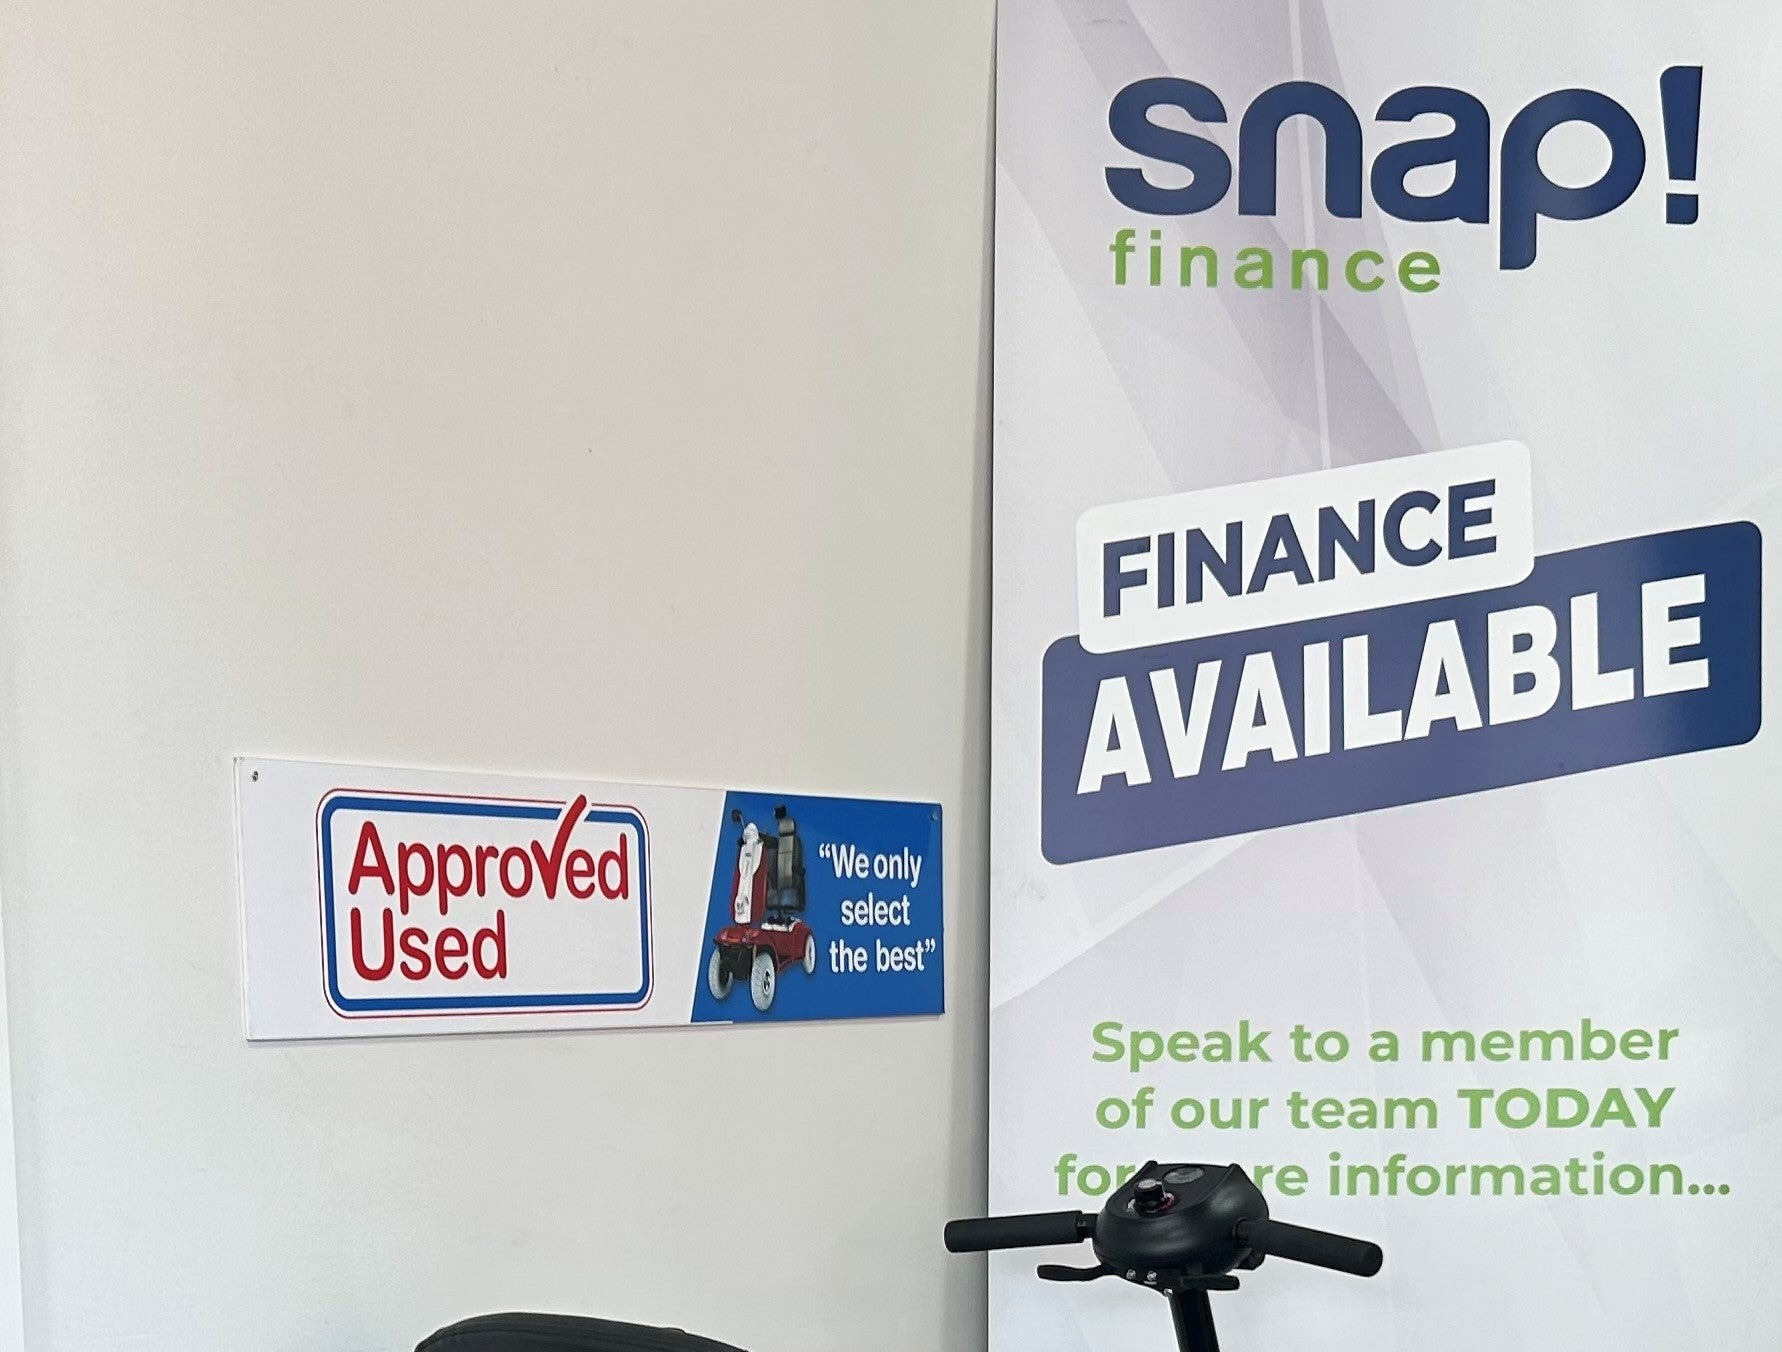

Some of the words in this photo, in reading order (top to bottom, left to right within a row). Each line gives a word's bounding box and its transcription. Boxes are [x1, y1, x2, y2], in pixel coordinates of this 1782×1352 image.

[1104, 64, 1704, 270] snap!
[1110, 228, 1442, 293] finance
[1101, 478, 1499, 618] FINANCE
[1076, 573, 1711, 796] AVAILABLE
[347, 793, 631, 915] Approved
[818, 843, 870, 879] “We
[873, 846, 923, 889] only
[840, 891, 911, 926] select
[349, 907, 509, 982] Used
[828, 940, 868, 973] the
[875, 937, 937, 972] best”
[1092, 1019, 1270, 1073] Speak
[1290, 1023, 1349, 1062] to
[1368, 1030, 1399, 1062] a
[1421, 1018, 1680, 1062] member
[1095, 1086, 1155, 1129] of
[1170, 1098, 1270, 1130] our
[1287, 1092, 1439, 1129] team
[1457, 1087, 1675, 1129] TODAY
[1252, 1164, 1309, 1197] re
[1329, 1151, 1731, 1197] information...
